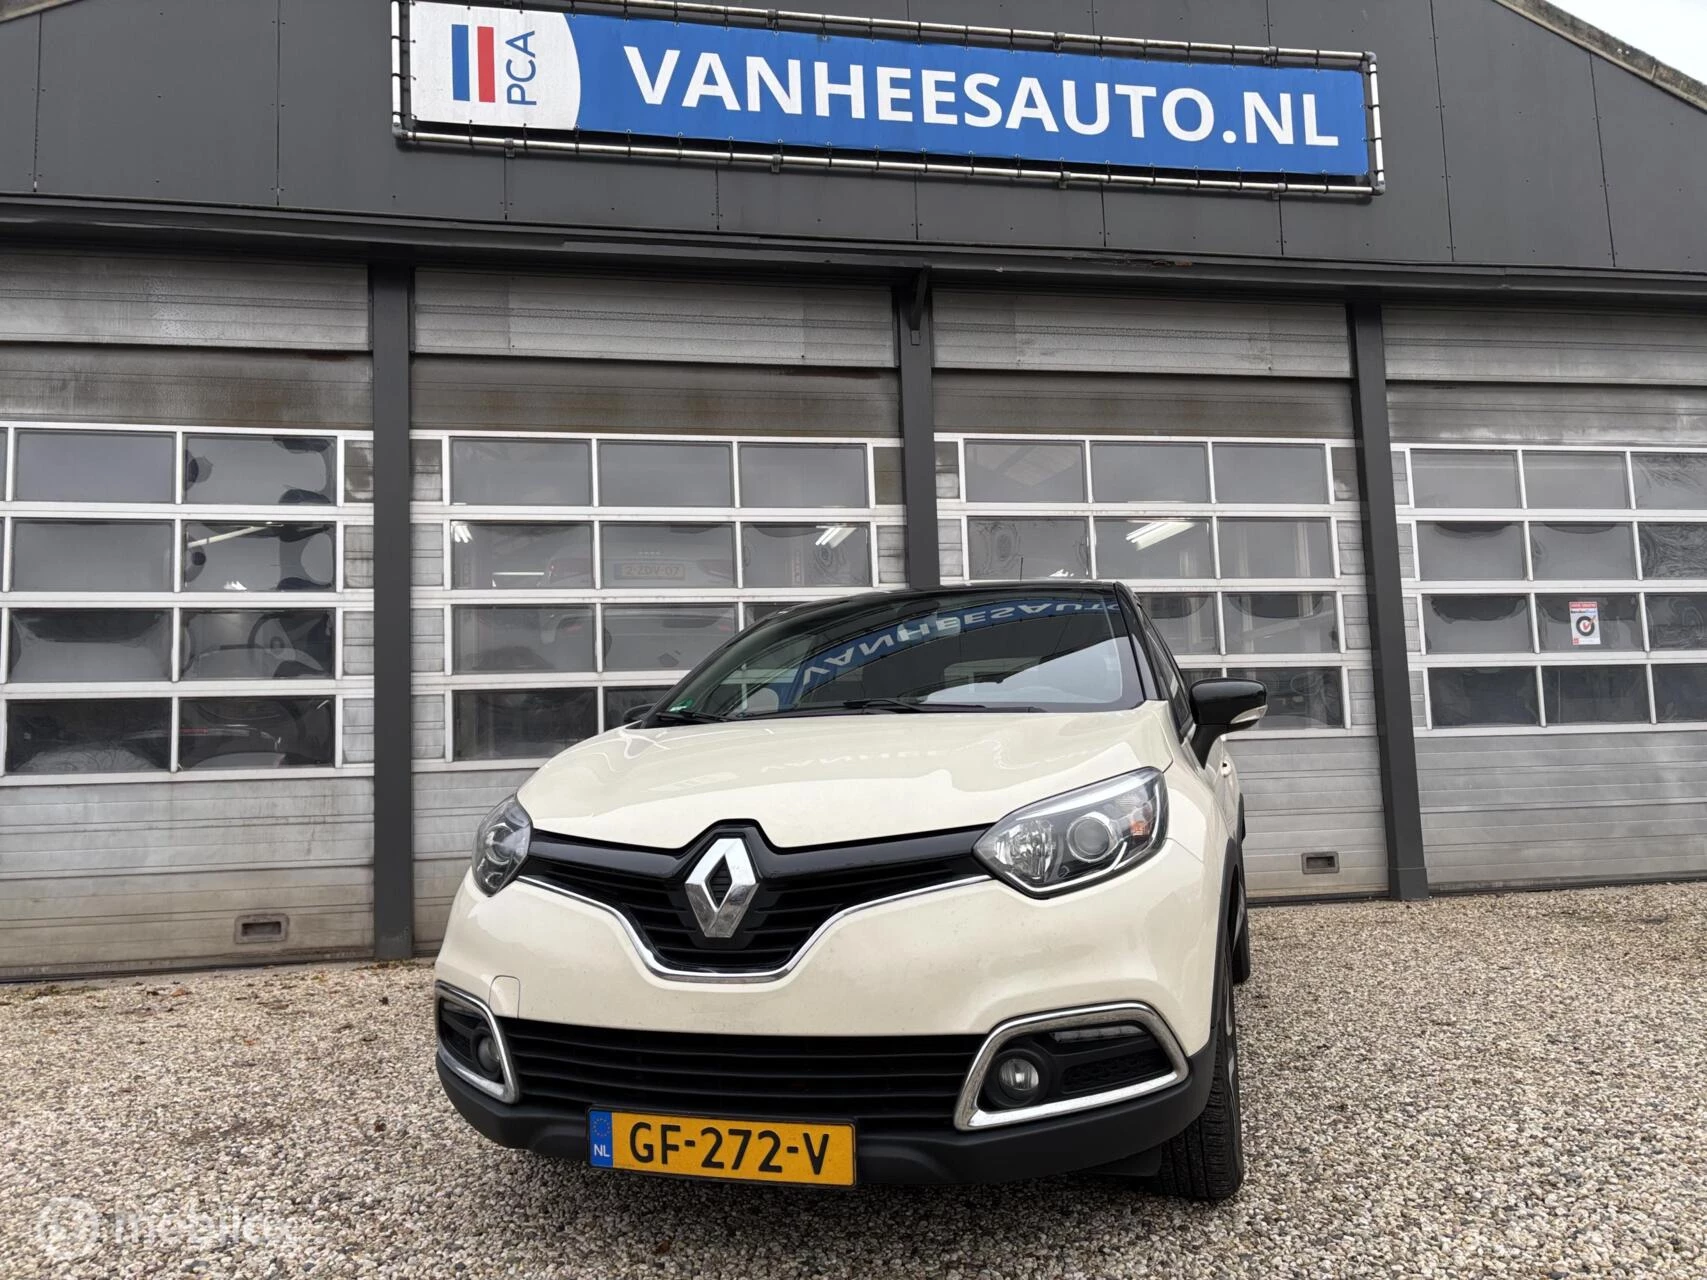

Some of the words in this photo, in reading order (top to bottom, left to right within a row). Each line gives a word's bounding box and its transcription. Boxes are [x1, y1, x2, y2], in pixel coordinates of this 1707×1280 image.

[505, 29, 538, 106] PCA
[623, 45, 1340, 147] VANHEESAUTO.NL
[593, 1143, 610, 1158] NL
[629, 1121, 830, 1176] GF-272-V
